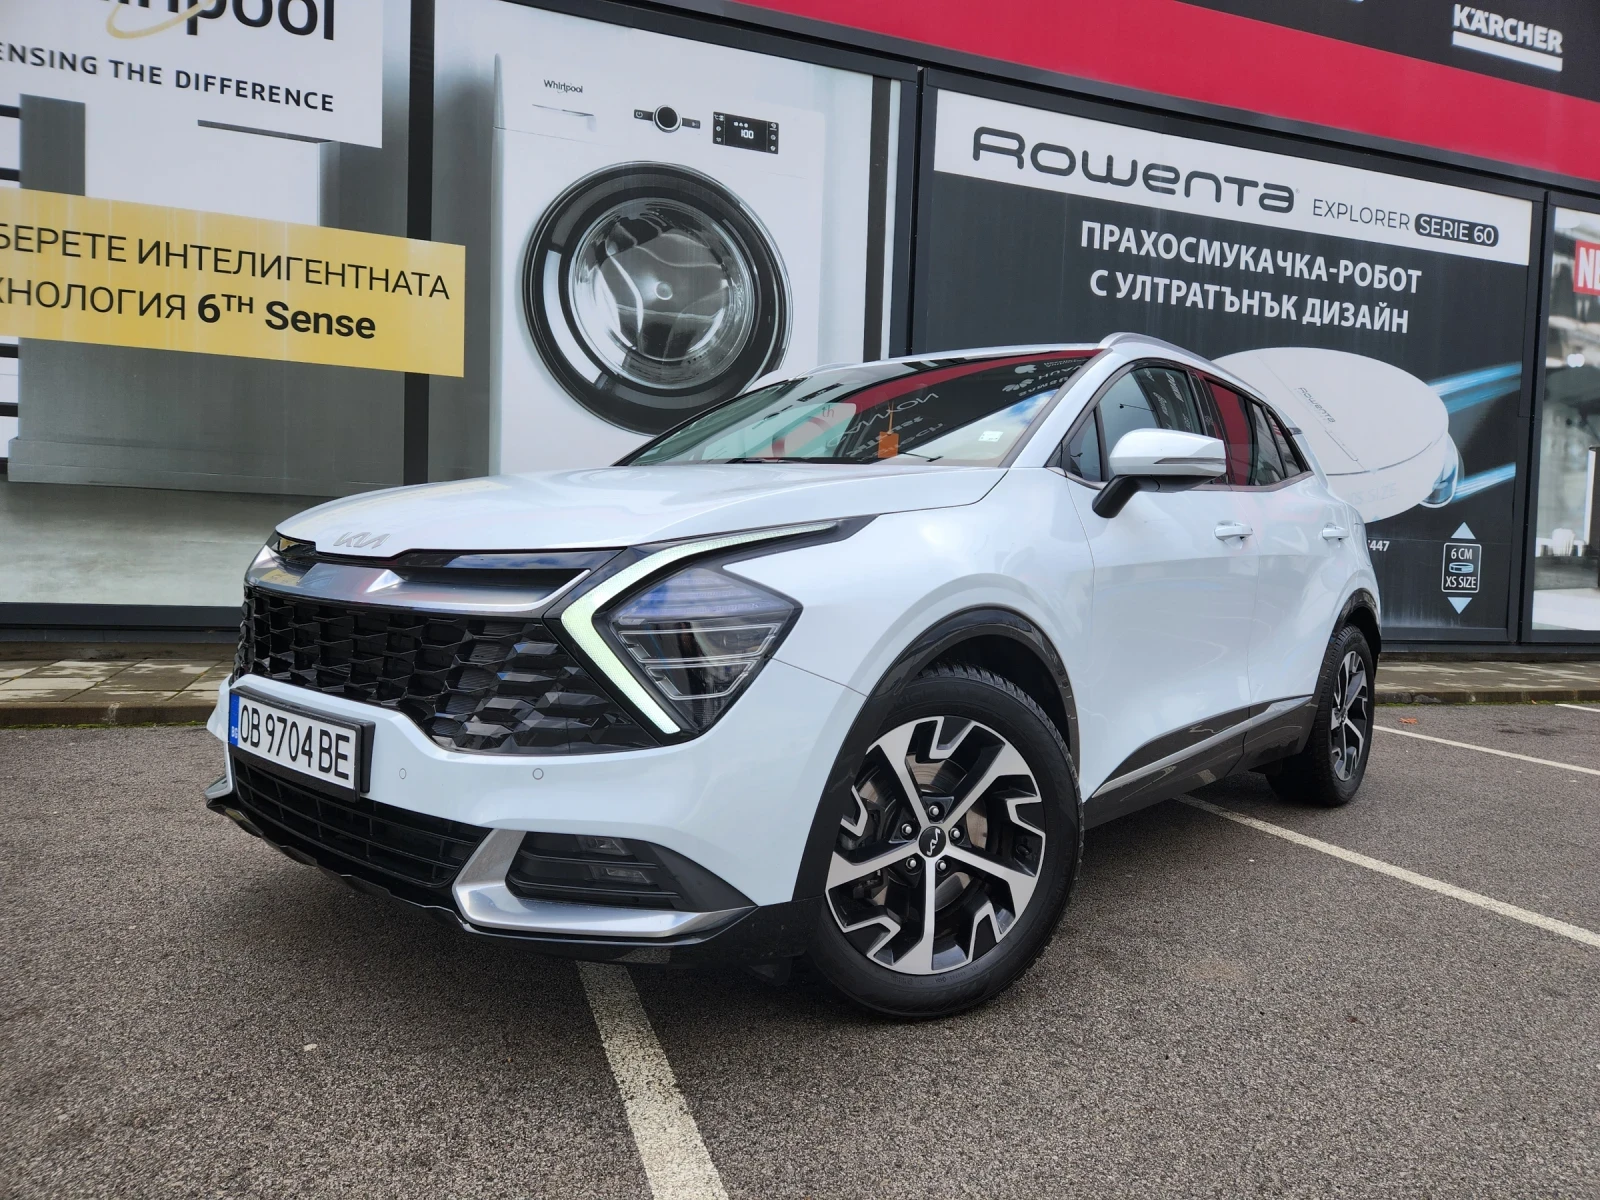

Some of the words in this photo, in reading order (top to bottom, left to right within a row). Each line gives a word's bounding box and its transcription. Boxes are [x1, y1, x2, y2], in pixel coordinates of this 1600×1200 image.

[1453, 4, 1563, 53] KÄRCHER
[108, 59, 163, 85] THE
[175, 70, 334, 112] DIFFERENCE
[543, 79, 584, 94] Whirlpool
[1312, 199, 1410, 230] EXPLORER
[1419, 216, 1470, 241] SERIE
[1474, 225, 1495, 245] 60
[138, 238, 450, 300] ИНТЕЛИГЕНТНАТА
[1080, 220, 1422, 294] ПРАХОСМУКАЧКА-РОБОТ
[0, 277, 186, 321] НОЛОГИЯ
[265, 300, 376, 340] Sense
[1116, 271, 1298, 322] УЛТРАТЪНЪК
[1302, 297, 1409, 334] ДИЗАЙН
[1368, 540, 1390, 552] 447
[1450, 548, 1457, 560] 6
[1458, 548, 1473, 560] CM
[1445, 576, 1457, 588] XS
[1458, 576, 1477, 588] SIZE
[240, 704, 261, 748] OB
[265, 713, 313, 768] 9704
[318, 728, 350, 781] BE
